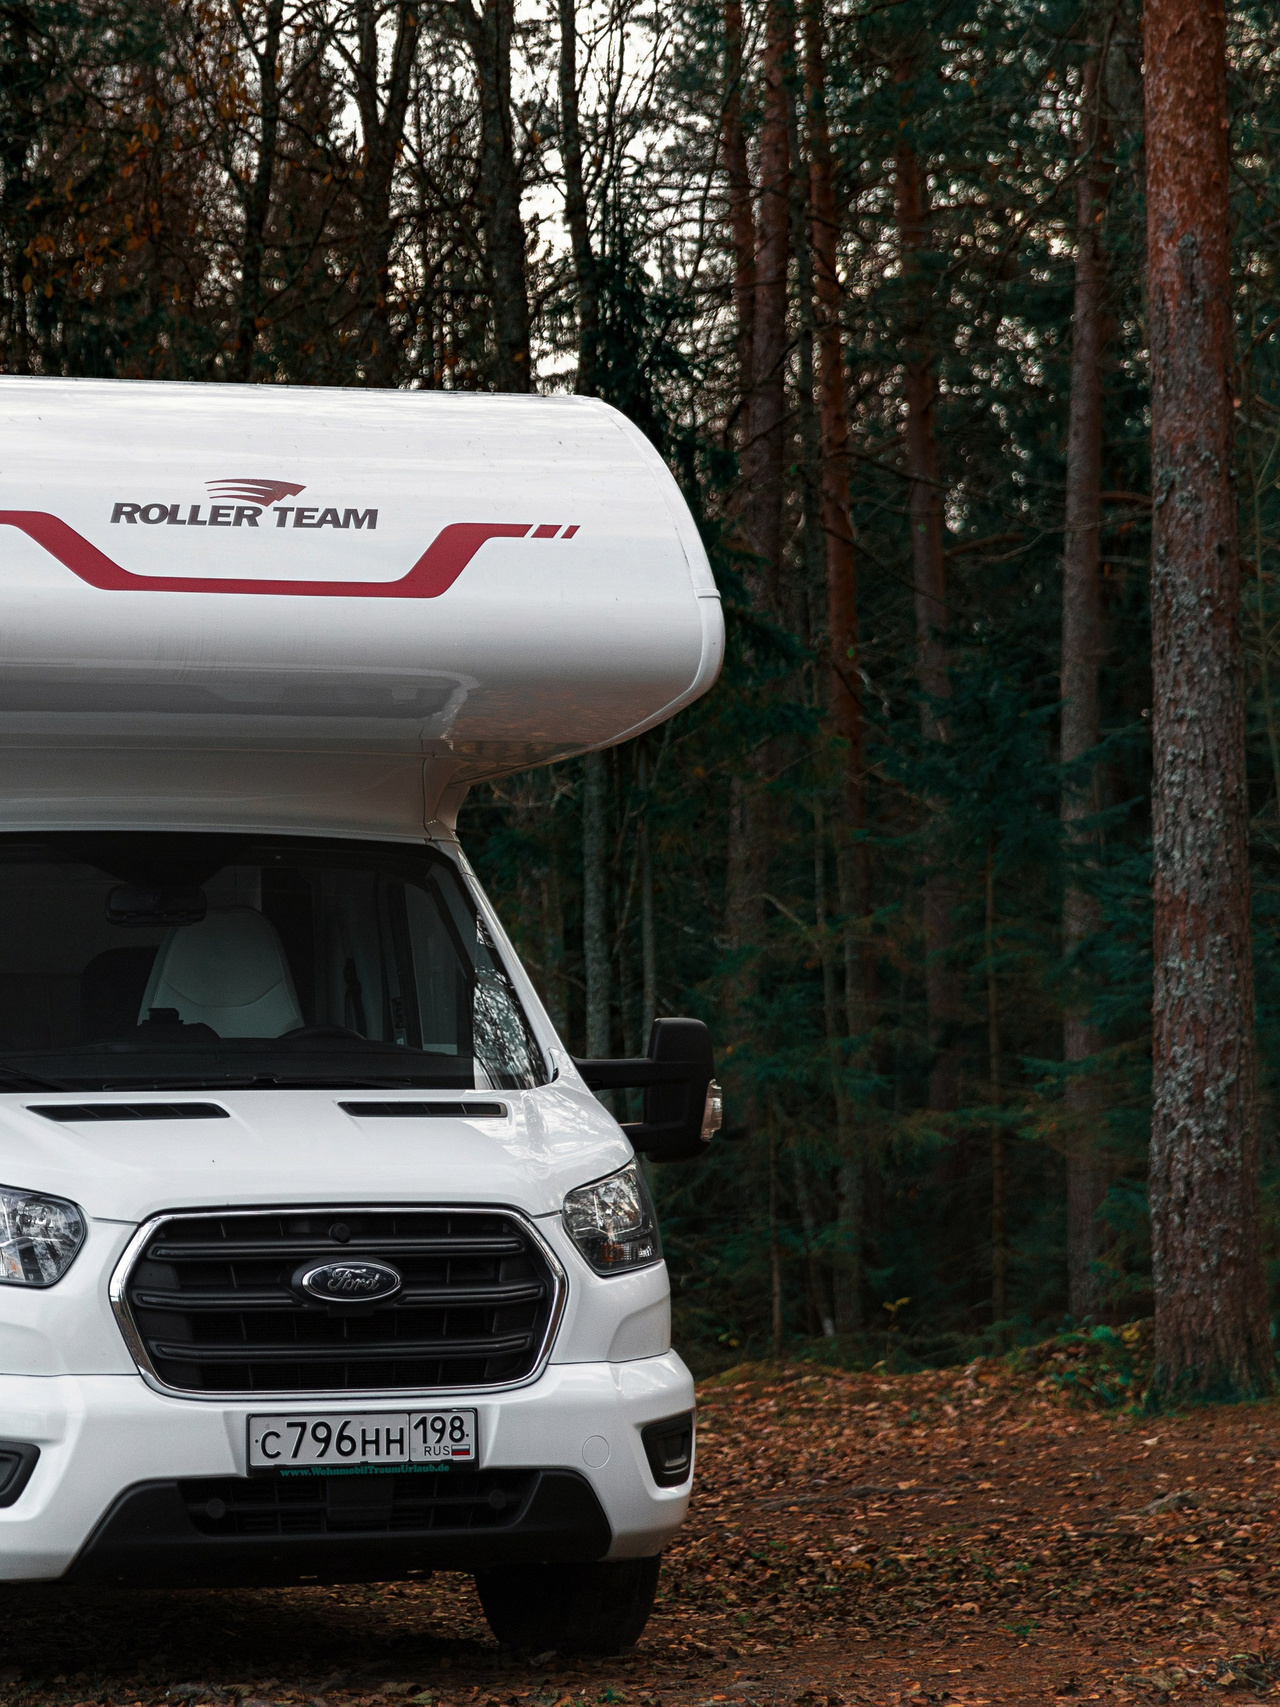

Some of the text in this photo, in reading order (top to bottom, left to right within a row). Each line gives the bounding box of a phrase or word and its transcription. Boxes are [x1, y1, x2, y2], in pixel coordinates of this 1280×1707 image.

[110, 502, 378, 530] ROLLER TEAM
[327, 1267, 380, 1292] Ford
[413, 1415, 465, 1444] 198
[424, 1445, 450, 1456] RUS
[280, 1464, 450, 1477] www.WohnmobilTraumUrlaub.de
